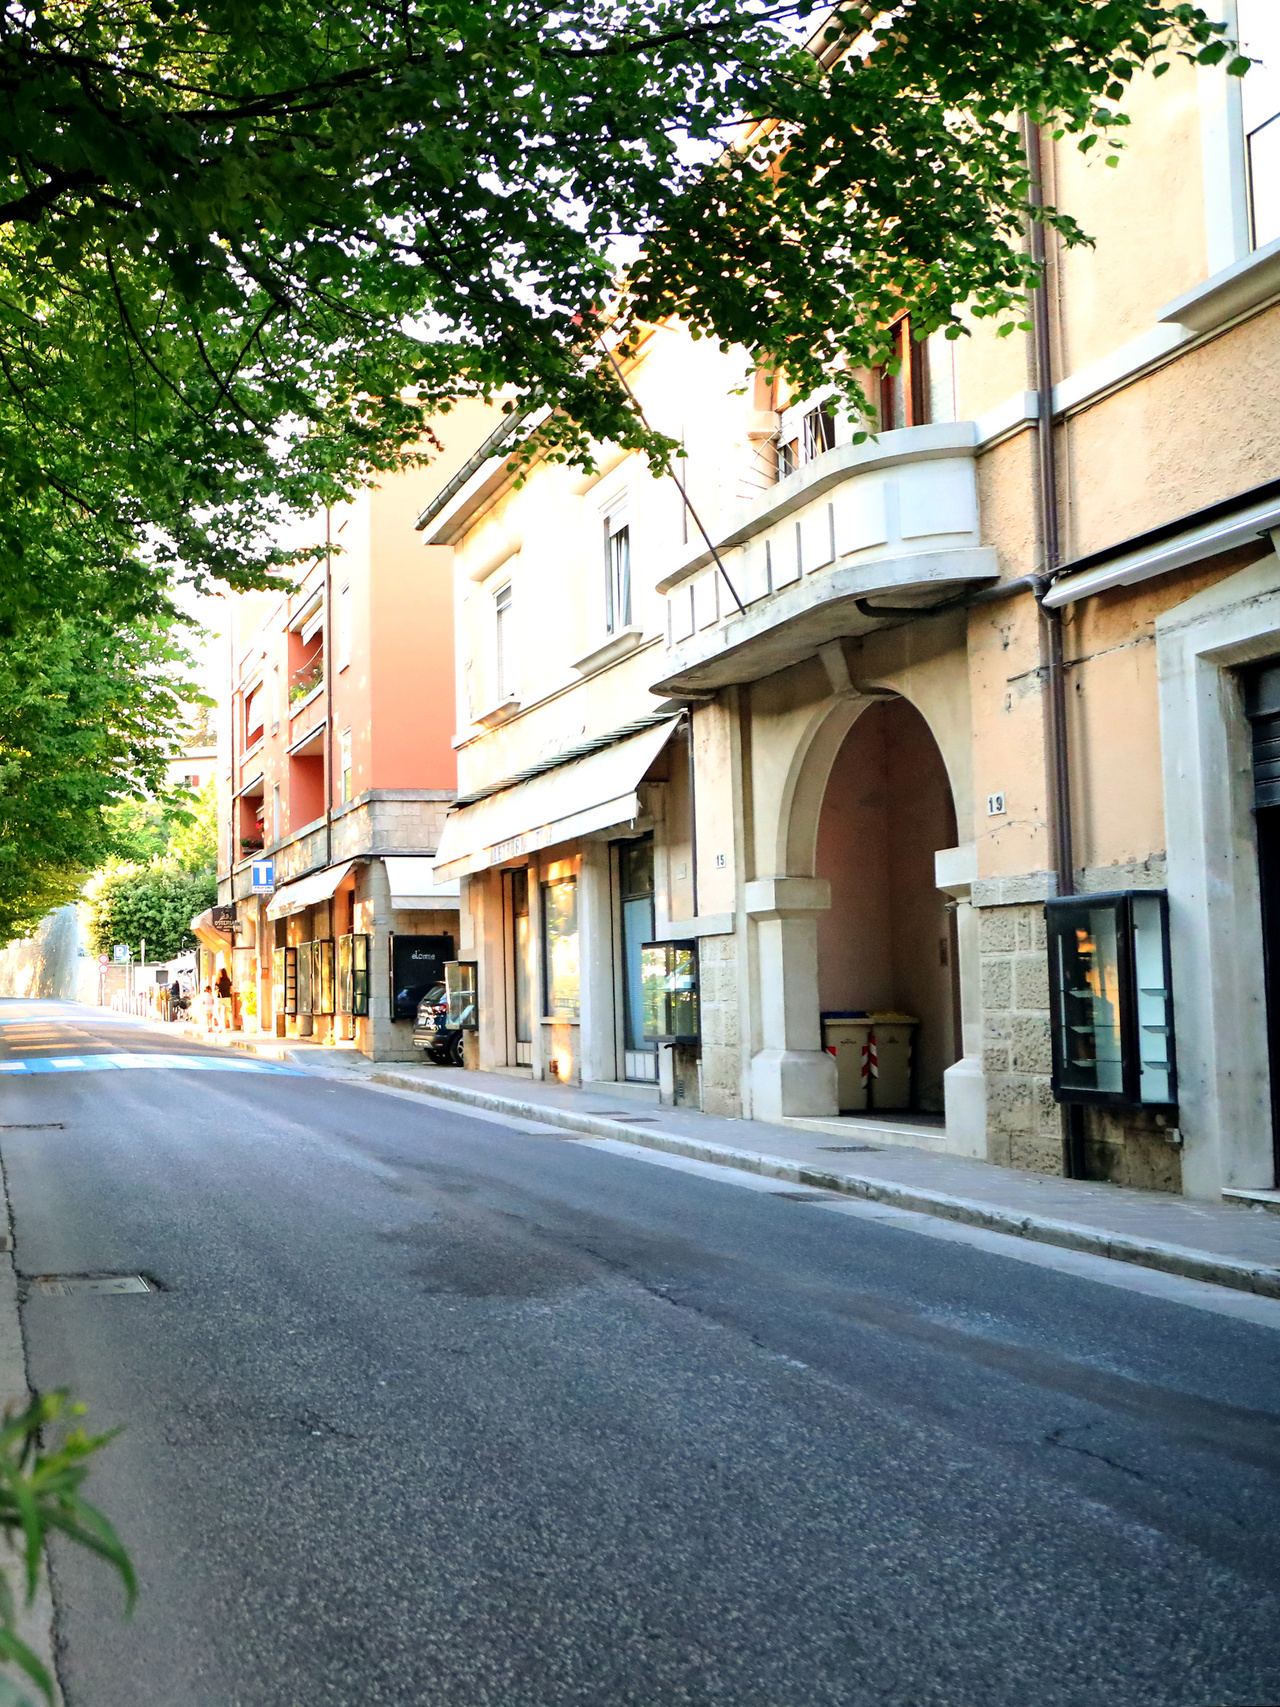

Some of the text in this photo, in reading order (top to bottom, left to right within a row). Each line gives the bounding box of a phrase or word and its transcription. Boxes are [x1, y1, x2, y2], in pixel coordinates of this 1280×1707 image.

[988, 796, 1003, 812] 19
[716, 854, 725, 866] 15
[253, 861, 273, 885] T
[115, 946, 125, 957] P
